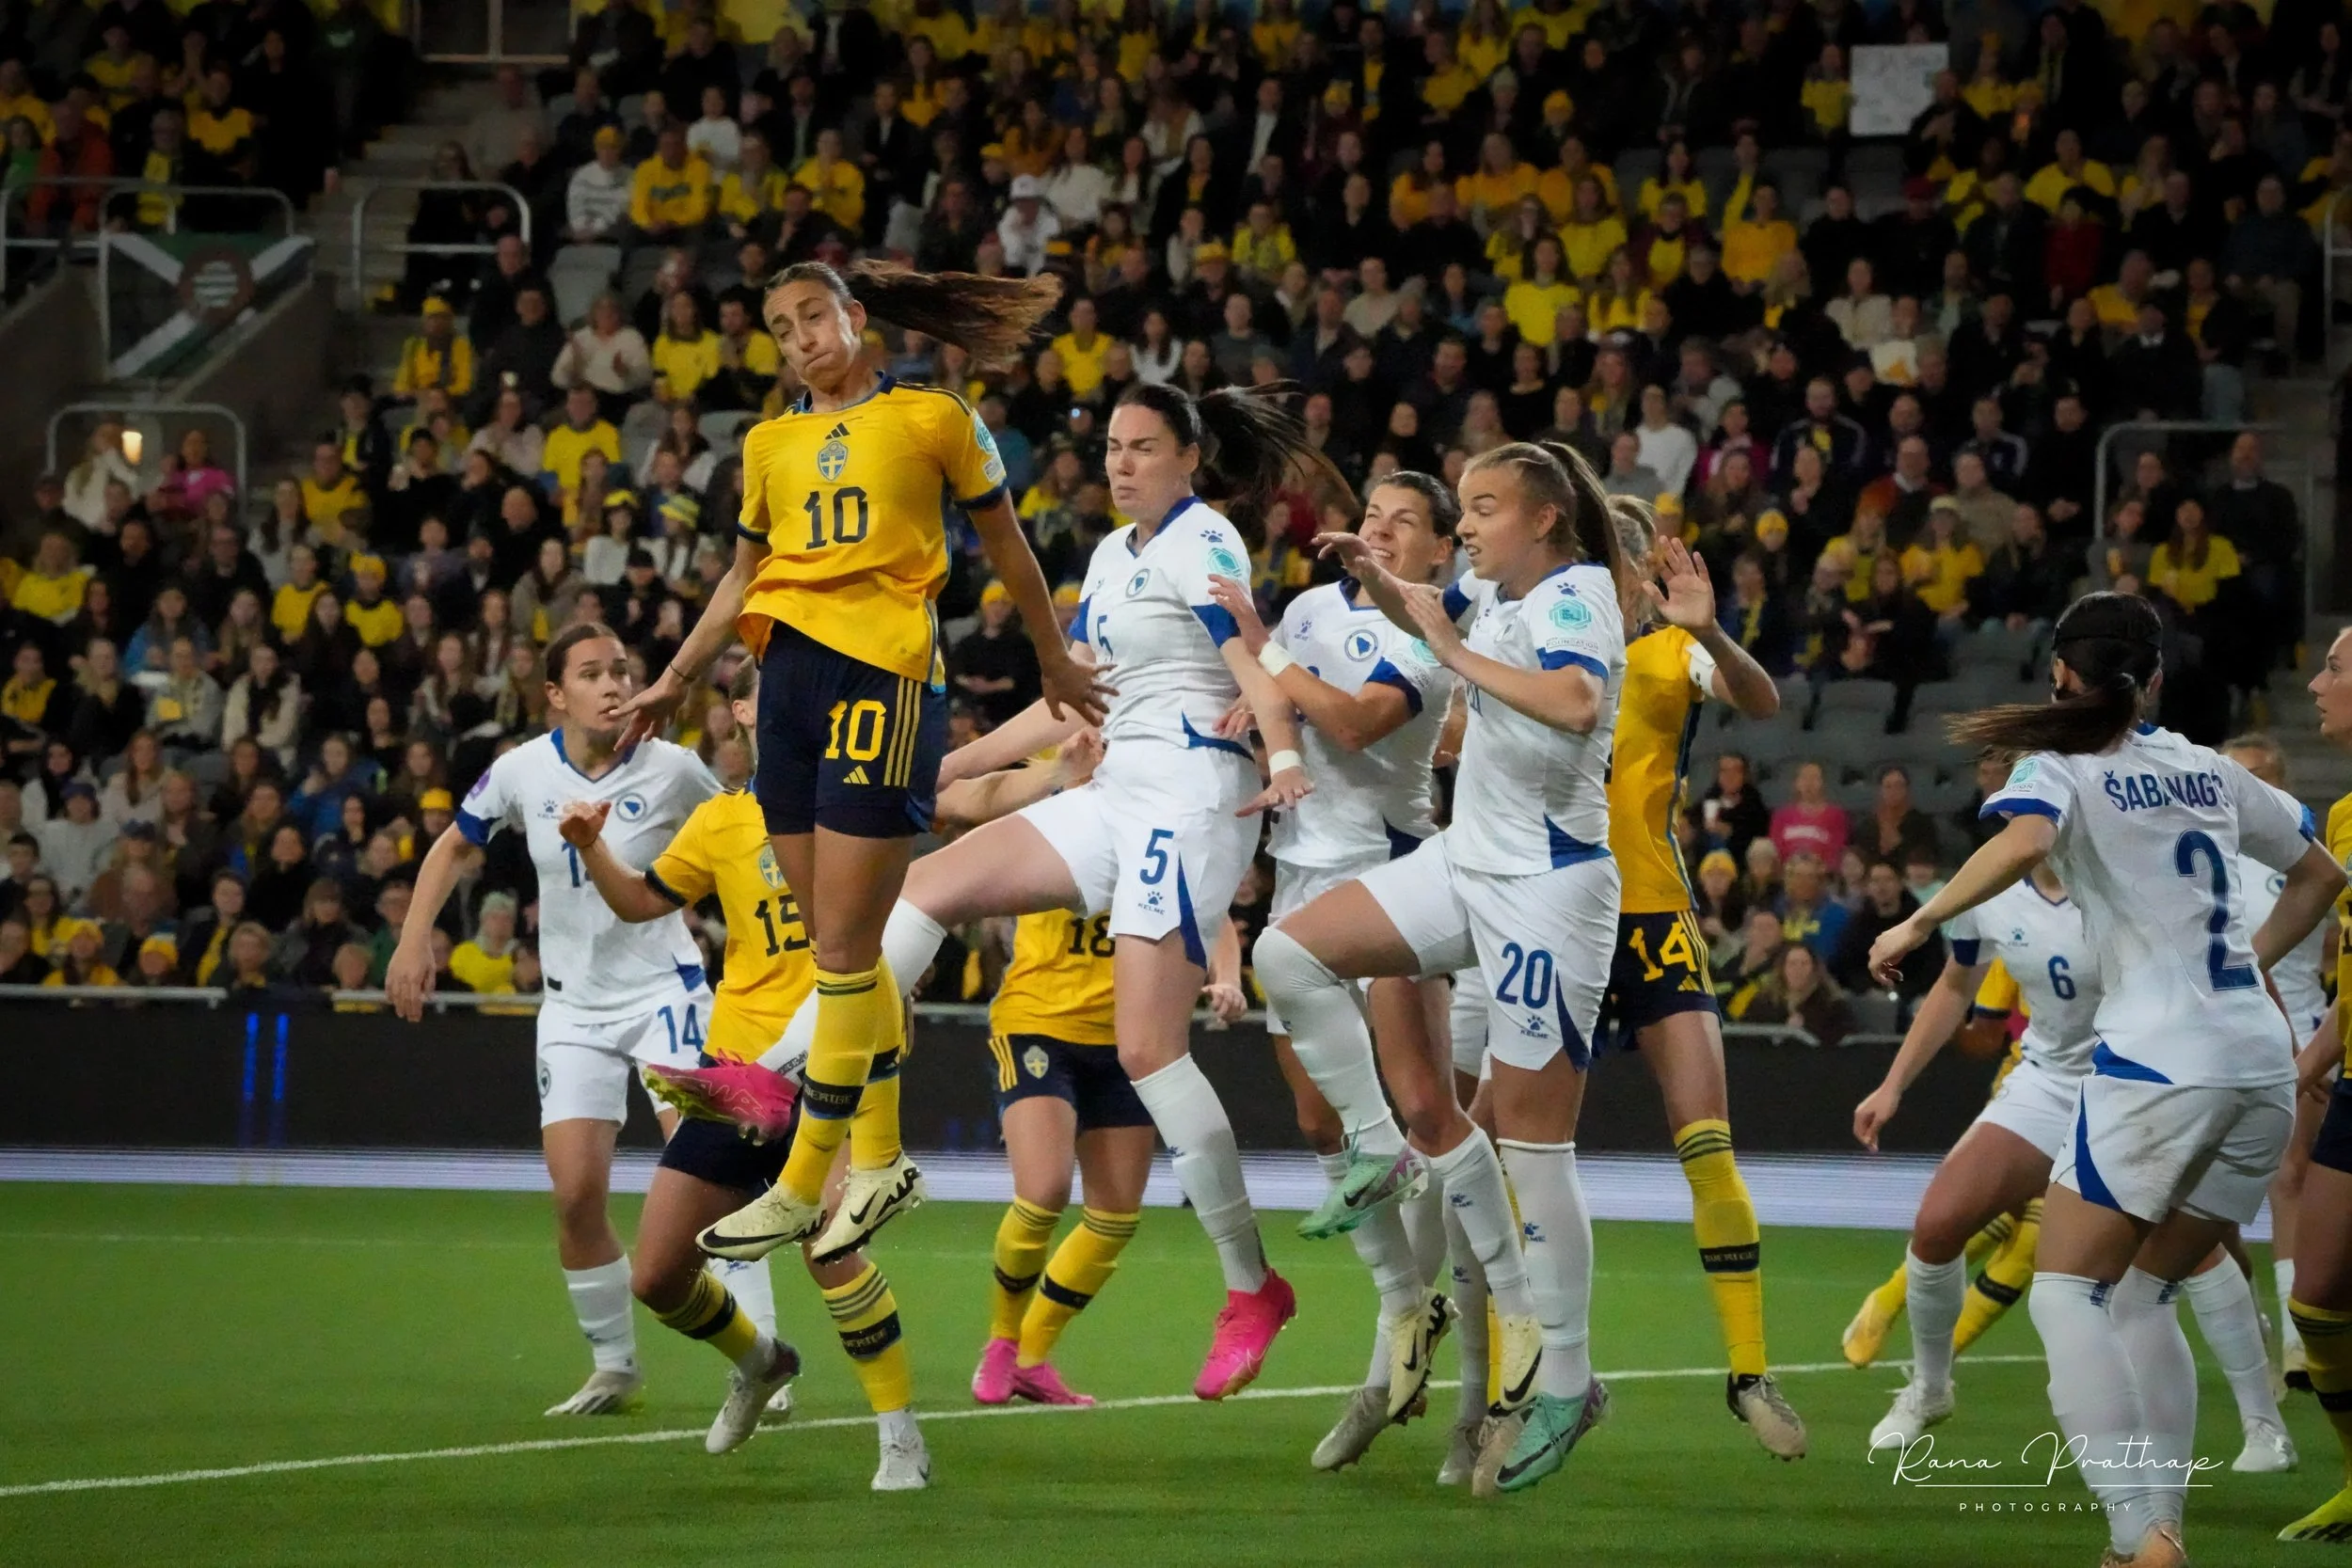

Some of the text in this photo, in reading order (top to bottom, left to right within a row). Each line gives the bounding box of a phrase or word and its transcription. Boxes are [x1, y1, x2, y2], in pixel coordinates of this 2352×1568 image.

[803, 486, 868, 549] 10
[824, 699, 886, 761] 10
[1139, 829, 1174, 885] 5
[755, 895, 811, 958] 15
[1068, 915, 1117, 958] 18
[1137, 902, 1166, 916] KELME
[2174, 828, 2260, 991] 2
[1496, 942, 1552, 1009] 20
[1629, 922, 1697, 983] 14
[2047, 956, 2077, 1002] 6
[658, 1004, 705, 1054] 14
[1519, 1029, 1549, 1039] KELME
